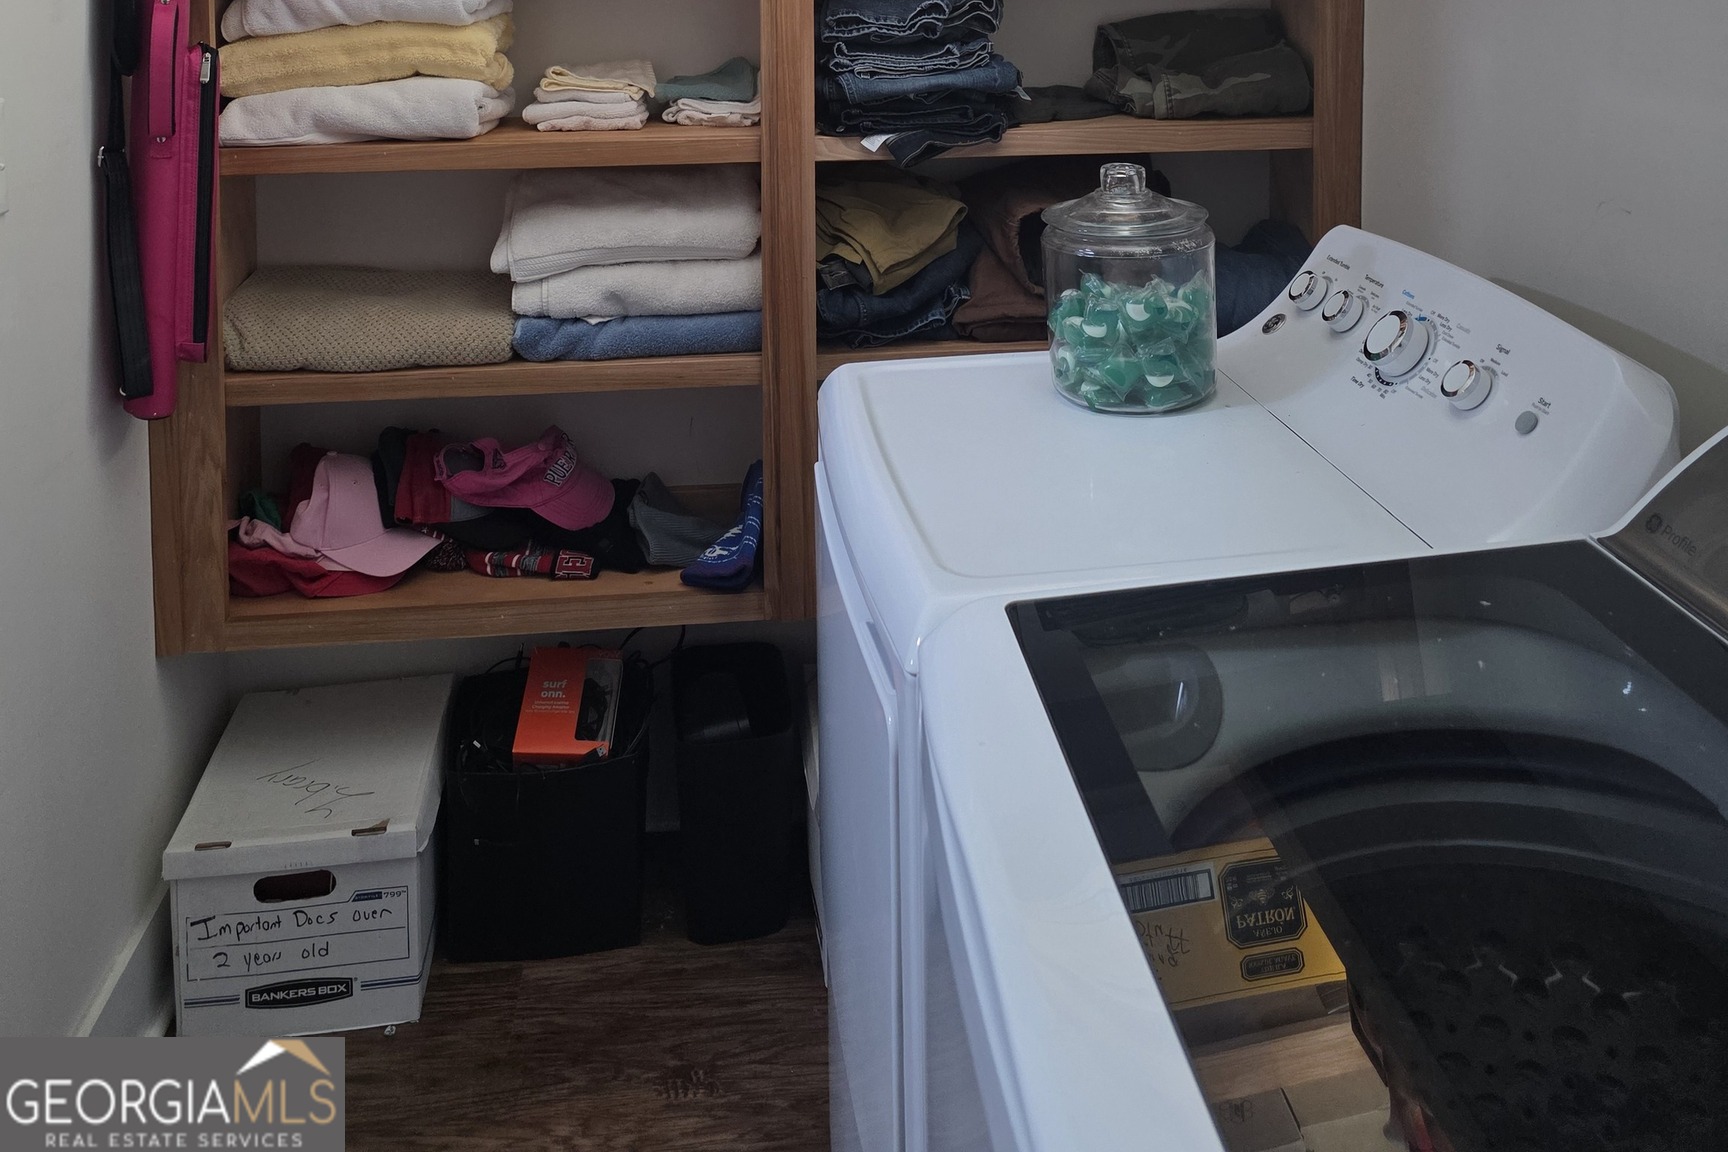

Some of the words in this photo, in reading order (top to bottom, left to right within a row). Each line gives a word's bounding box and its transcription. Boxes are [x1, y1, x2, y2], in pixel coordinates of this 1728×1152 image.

[1364, 274, 1384, 289] Temperature
[1538, 397, 1551, 409] Start
[543, 450, 577, 488] PUER
[1661, 524, 1697, 557] Profile
[542, 679, 568, 688] surf
[541, 690, 566, 698] onn.
[190, 915, 283, 942] Important
[293, 909, 339, 928] Docs
[352, 907, 393, 922] over
[213, 951, 231, 968] 2
[243, 951, 282, 972] years
[301, 941, 329, 959] old
[252, 987, 316, 1002] BANKERS
[318, 983, 347, 995] BOX
